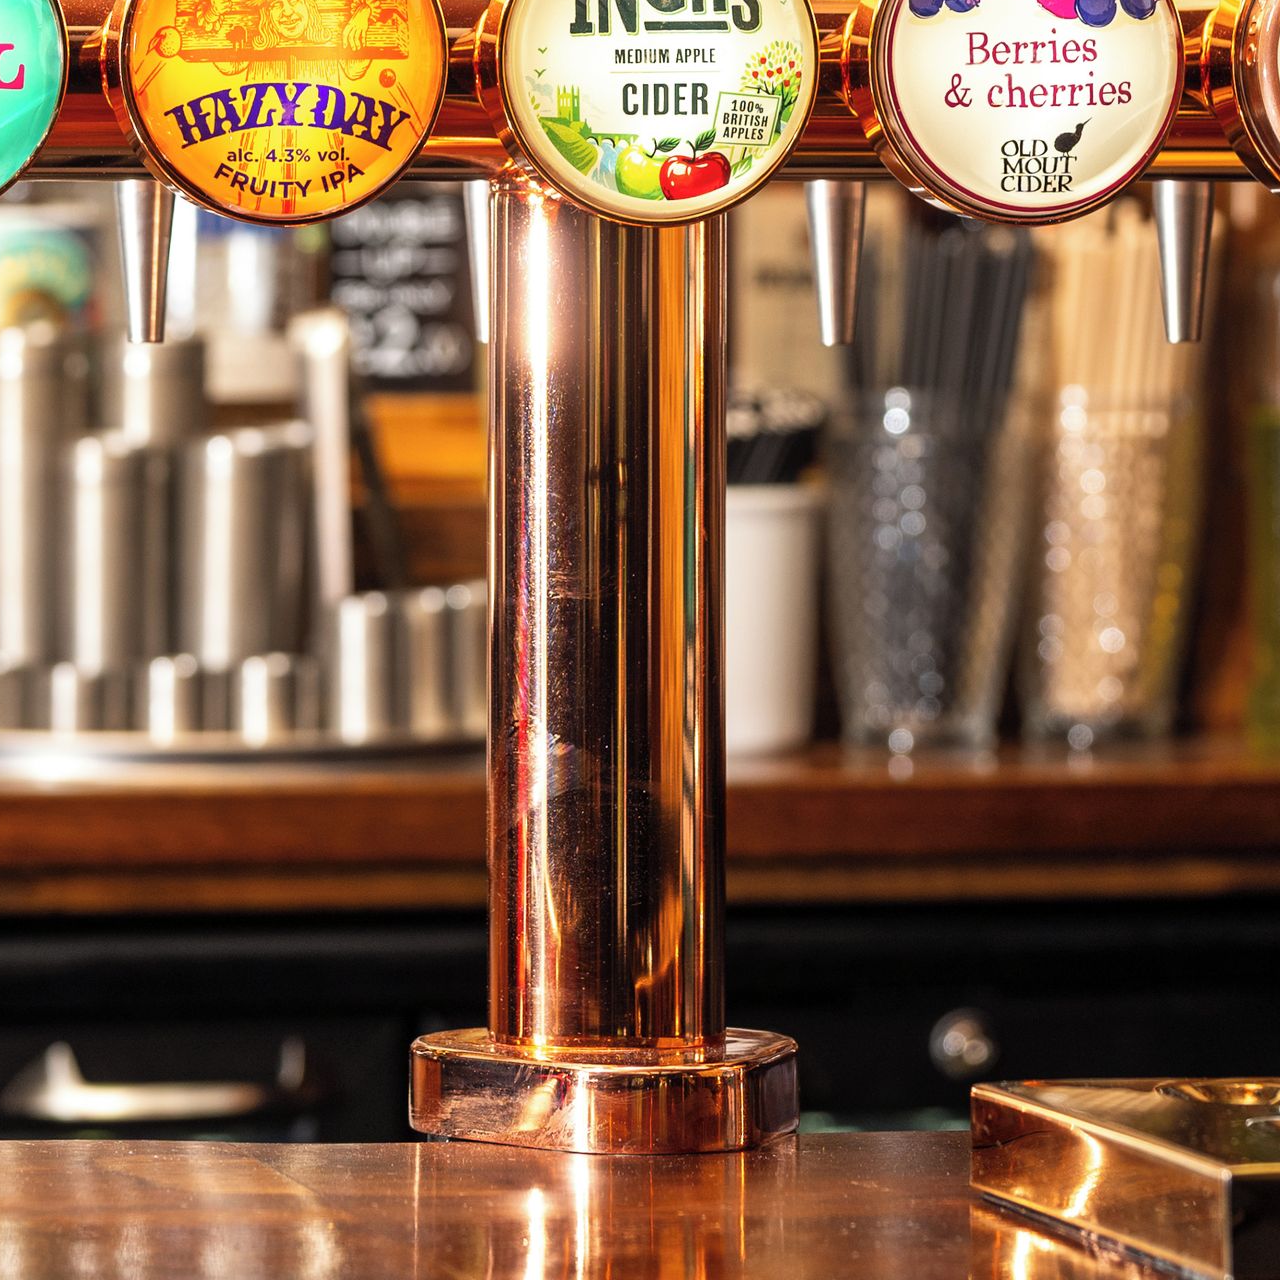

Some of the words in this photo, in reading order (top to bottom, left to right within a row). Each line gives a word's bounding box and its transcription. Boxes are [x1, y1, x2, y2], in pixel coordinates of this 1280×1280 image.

[614, 48, 670, 64] MEDIUM
[675, 47, 716, 64] APPLE
[965, 28, 1098, 66] Berries
[622, 82, 709, 116] CIDER
[944, 73, 972, 108] &
[987, 71, 1132, 109] cherries
[730, 99, 764, 114] 100%
[722, 112, 769, 128] BRITISH
[722, 126, 764, 141] APPLES
[227, 148, 259, 163] alc.
[265, 148, 311, 163] 4.3%
[317, 147, 350, 162] vol.
[1001, 139, 1048, 158] OLD
[1001, 155, 1078, 175] MOUT
[213, 163, 312, 199] FRUITY
[322, 167, 365, 193] IPA
[1000, 174, 1074, 193] CIDER
